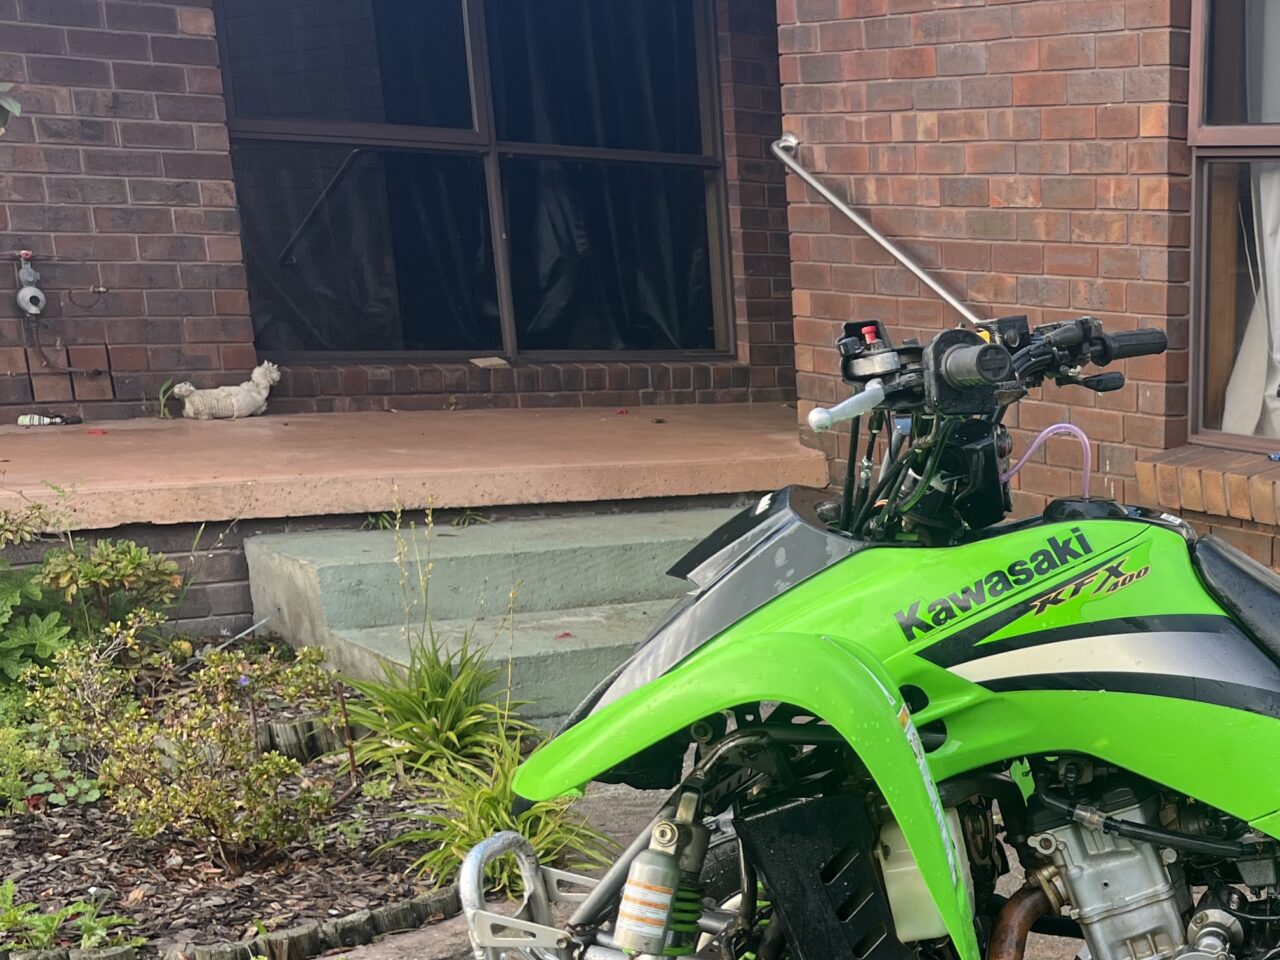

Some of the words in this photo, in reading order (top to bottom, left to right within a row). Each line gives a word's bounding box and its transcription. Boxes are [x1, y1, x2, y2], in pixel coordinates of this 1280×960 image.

[893, 526, 1094, 642] Kawasaki
[1030, 557, 1129, 617] KFX
[1104, 565, 1151, 595] 400
